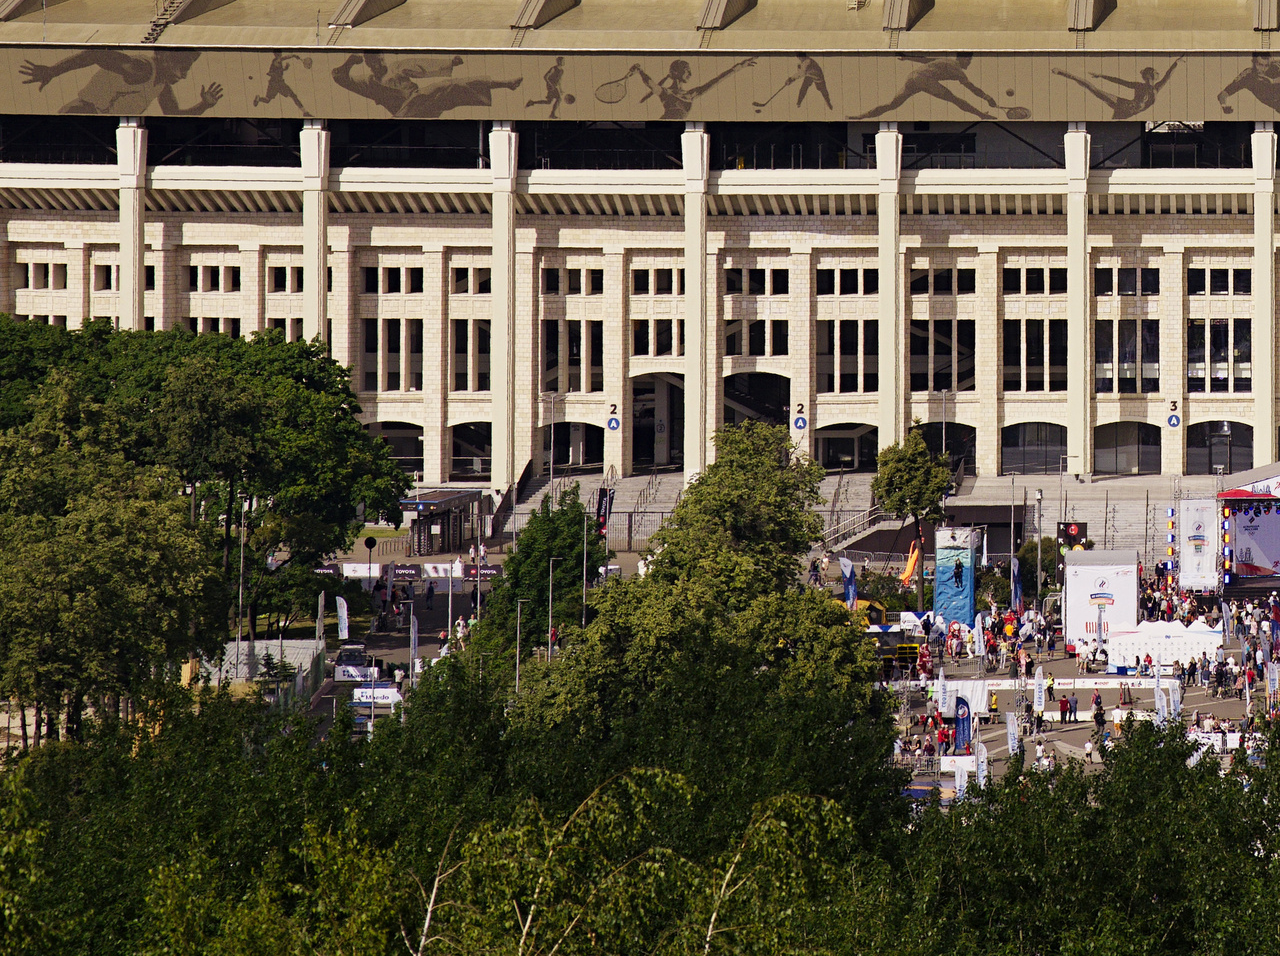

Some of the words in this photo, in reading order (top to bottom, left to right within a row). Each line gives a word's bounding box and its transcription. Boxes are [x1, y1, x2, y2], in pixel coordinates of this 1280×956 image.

[610, 404, 617, 414] 2
[797, 404, 804, 414] 2
[1170, 401, 1177, 411] 3
[609, 419, 617, 428] A
[796, 419, 804, 427] A
[1170, 416, 1178, 425] A
